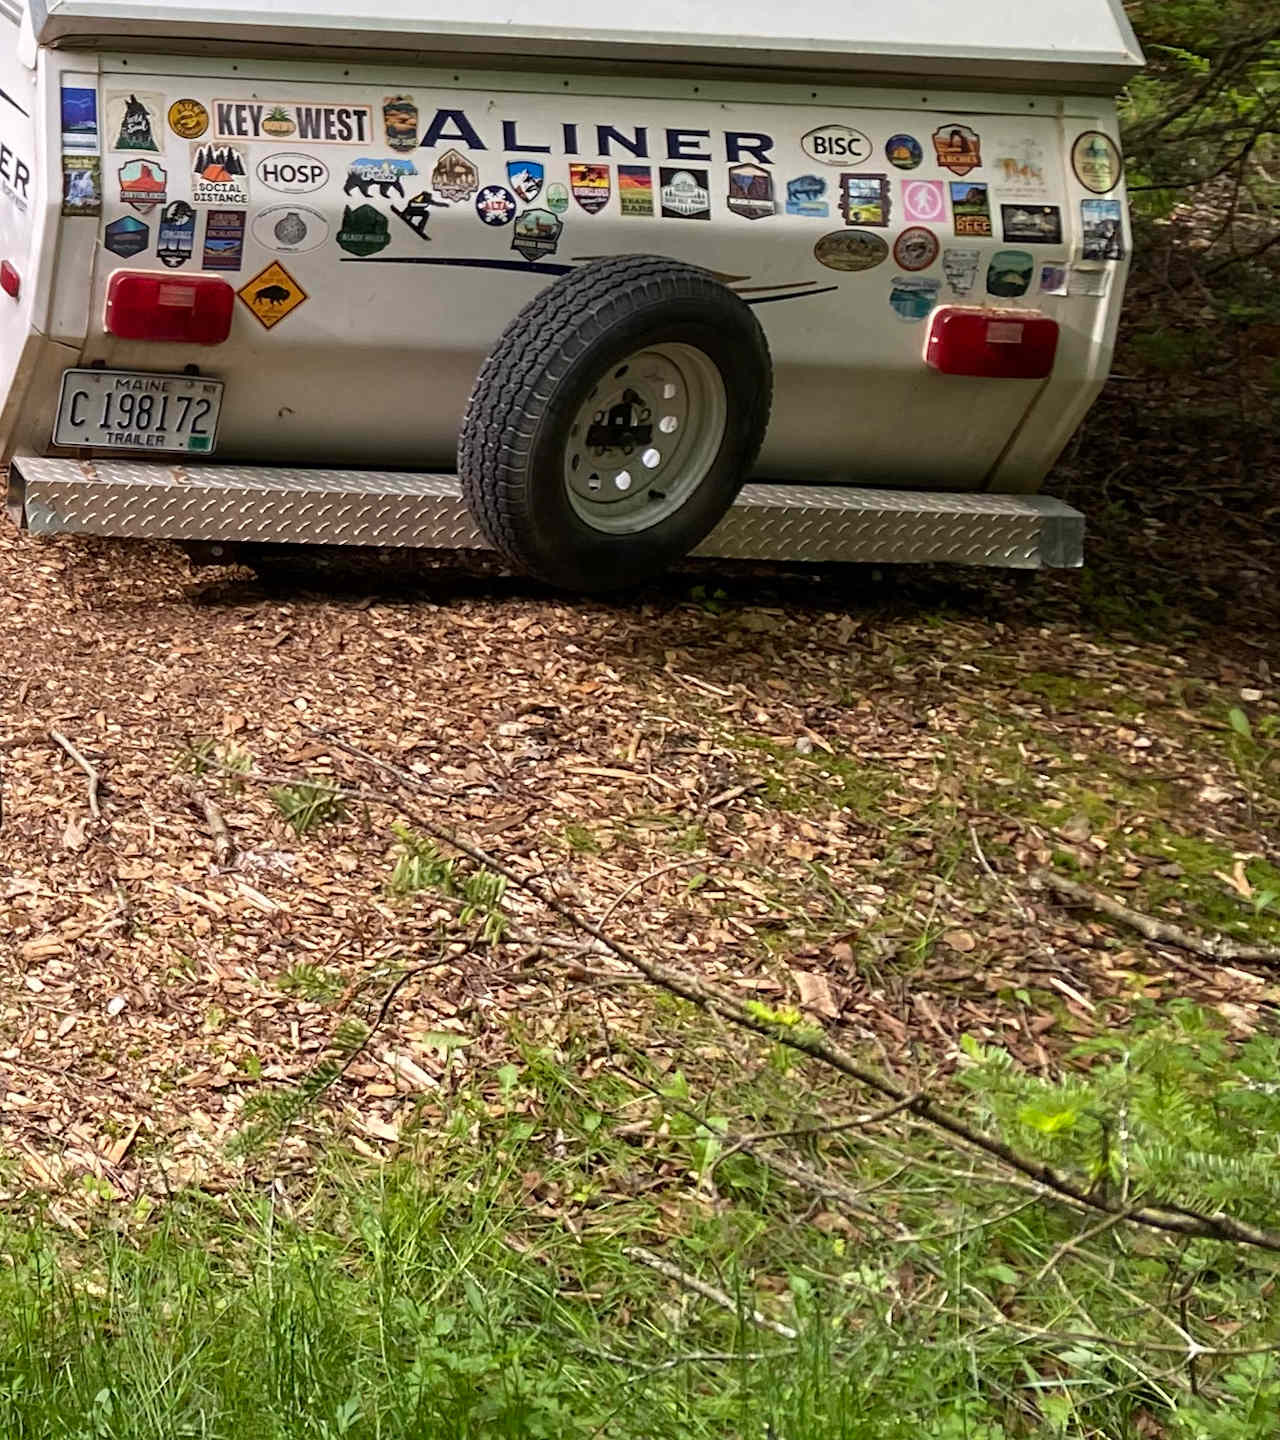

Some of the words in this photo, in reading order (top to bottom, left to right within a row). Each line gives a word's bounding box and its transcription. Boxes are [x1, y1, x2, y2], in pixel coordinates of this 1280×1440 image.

[217, 103, 263, 136] KEY
[295, 107, 368, 141] WEST
[419, 108, 775, 165] ALINER
[813, 136, 863, 156] BISC
[262, 164, 323, 183] HOSP
[198, 182, 243, 193] SOCIAL
[193, 193, 248, 203] DISTANCE
[115, 378, 171, 393] MAINE
[70, 391, 89, 427] C
[99, 392, 212, 435] 198172
[106, 432, 167, 447] TRAILER
